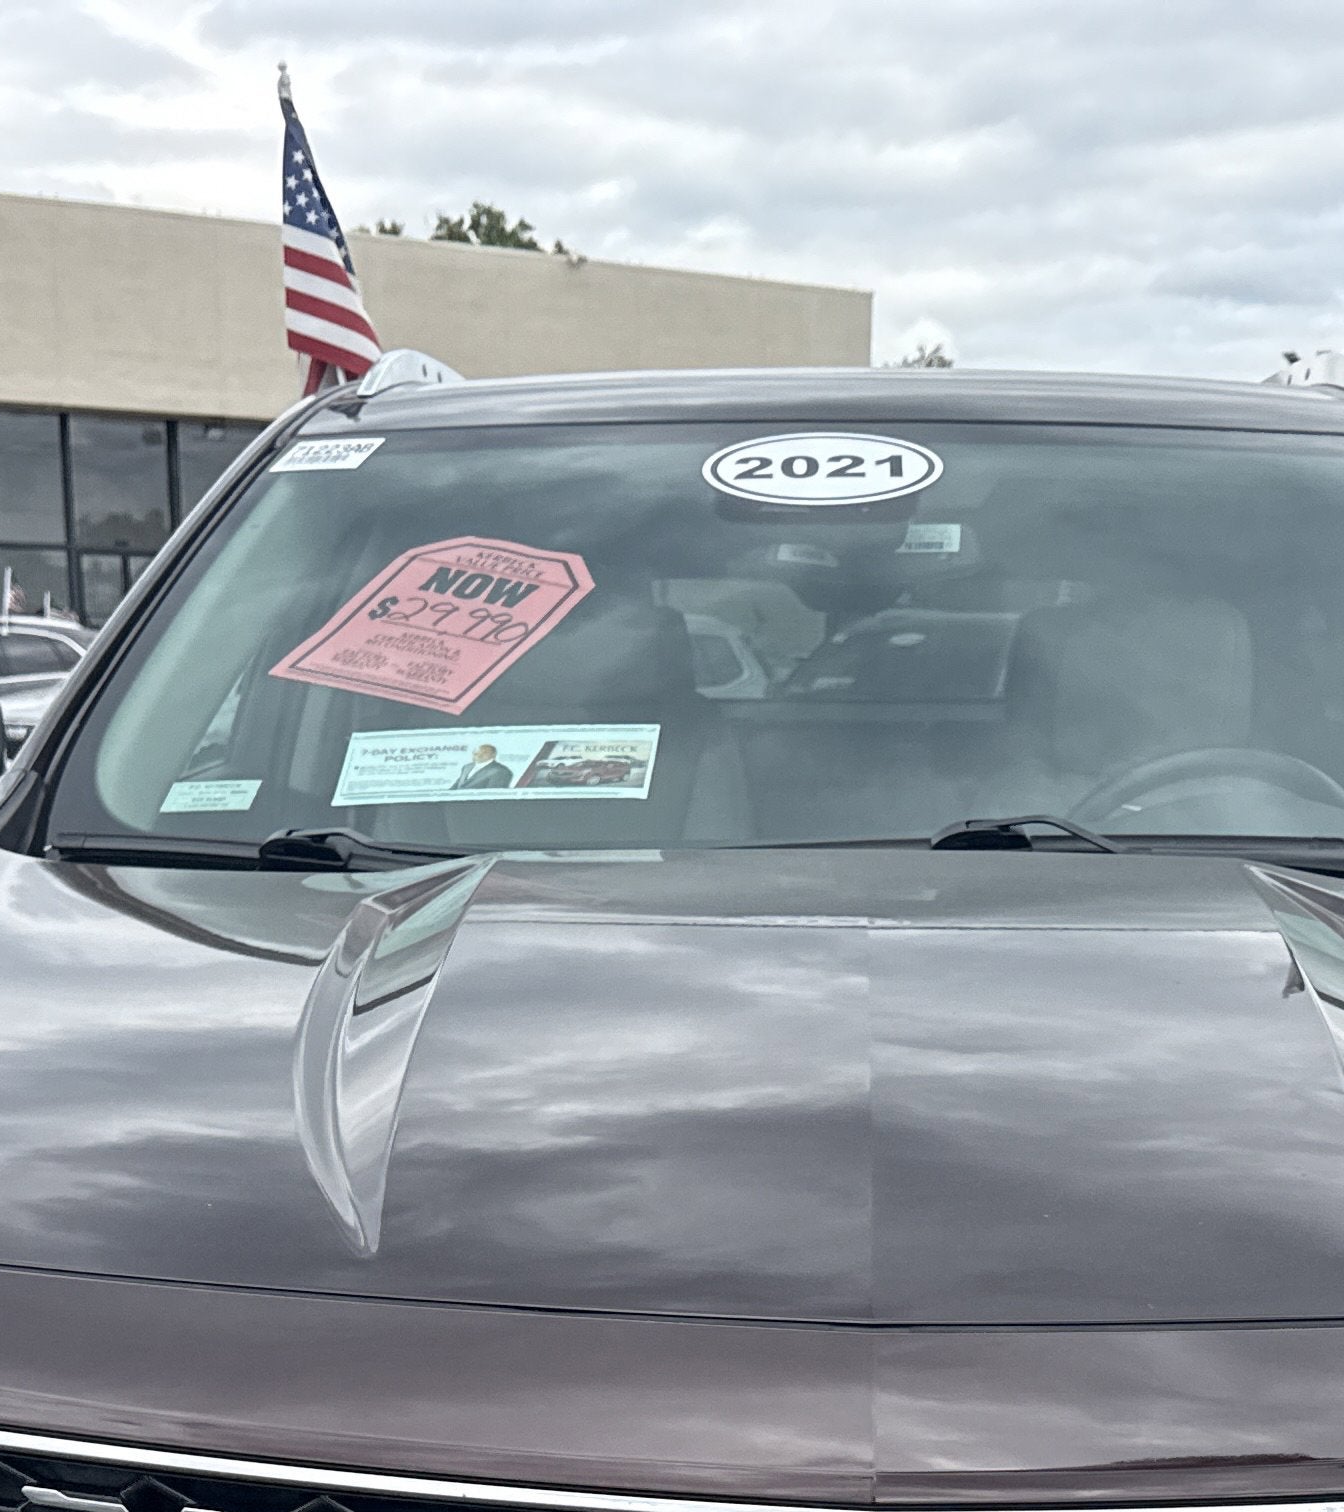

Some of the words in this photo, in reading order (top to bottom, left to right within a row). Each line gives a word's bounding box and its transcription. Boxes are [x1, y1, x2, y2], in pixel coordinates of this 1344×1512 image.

[733, 453, 906, 481] 2021
[418, 566, 540, 609] NOW
[361, 747, 398, 756] 7-DAY
[401, 744, 468, 755] EXCHANGE
[584, 745, 639, 753] KERBECK
[383, 754, 439, 763] POLICY:
